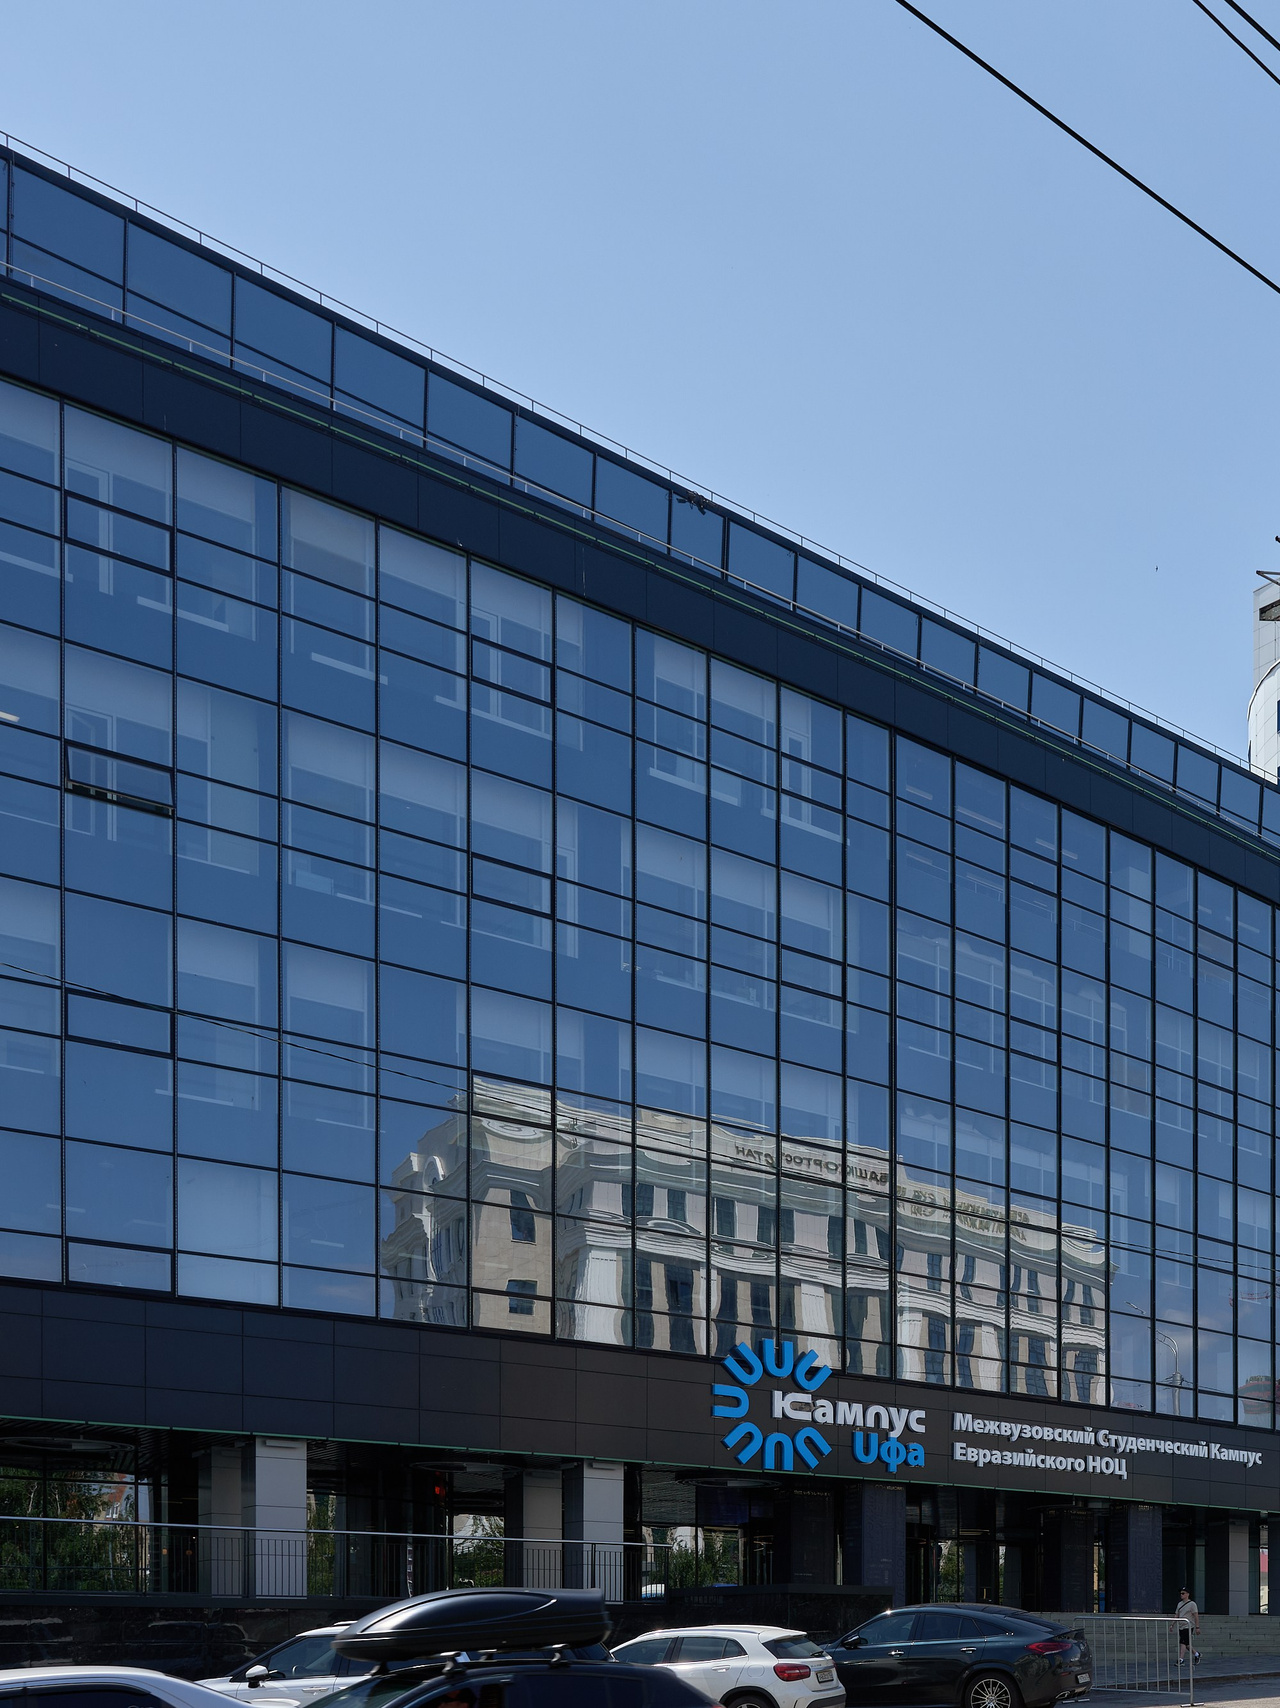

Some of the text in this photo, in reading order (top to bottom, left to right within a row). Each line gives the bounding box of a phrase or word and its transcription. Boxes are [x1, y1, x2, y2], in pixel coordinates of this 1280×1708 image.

[772, 1390, 925, 1438] Кампус
[953, 1412, 1263, 1468] Межвузовский Студенческий Кампус
[953, 1441, 1128, 1480] Евразийского НОЦ
